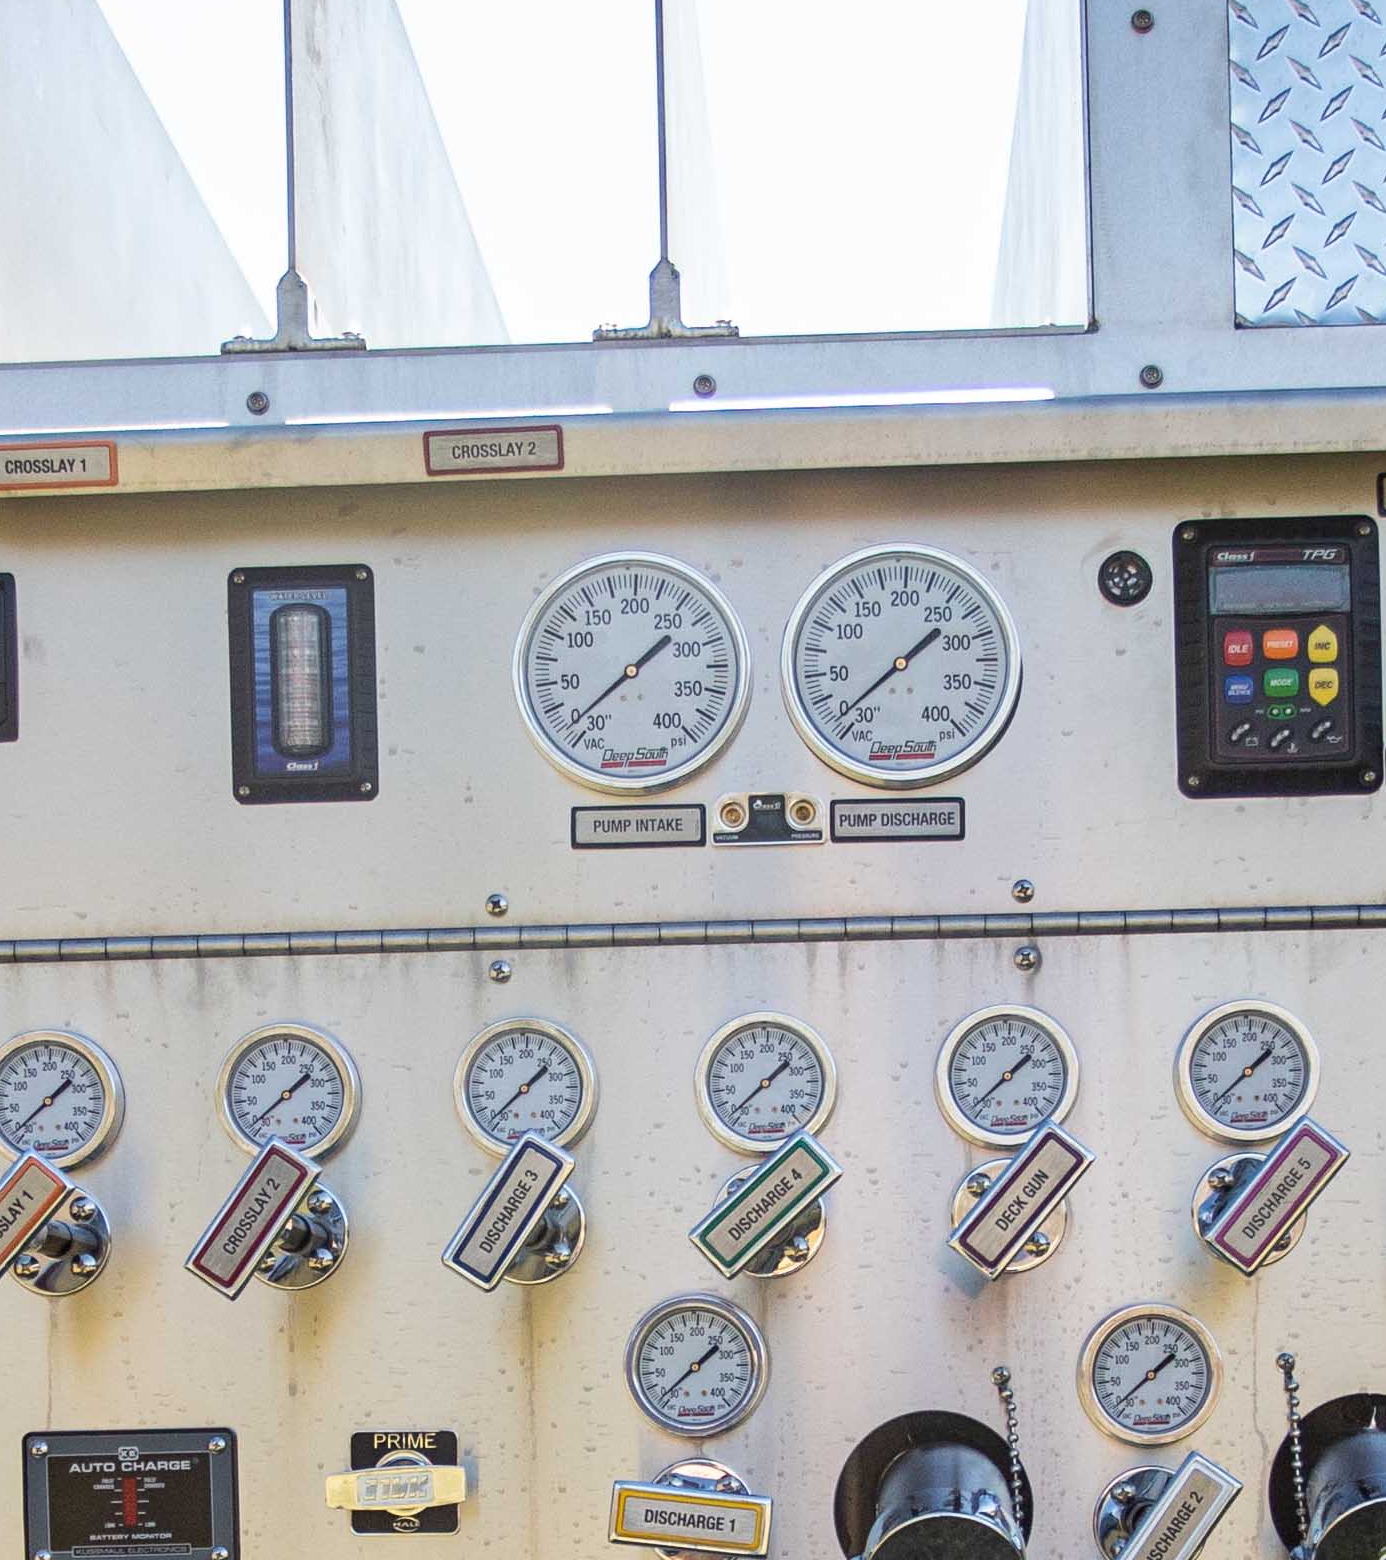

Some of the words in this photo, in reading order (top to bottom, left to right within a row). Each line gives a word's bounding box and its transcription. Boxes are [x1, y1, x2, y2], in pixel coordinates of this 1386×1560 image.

[451, 443, 524, 460] CROSSLAY
[527, 441, 537, 457] 2
[5, 458, 75, 476] CROSSLAY
[81, 458, 88, 474] 1
[1301, 548, 1337, 561] TPG
[620, 598, 650, 615] 200
[890, 590, 919, 607] 200
[854, 601, 881, 618] 150
[924, 606, 952, 623] 250
[585, 610, 612, 626] 150
[654, 614, 682, 630] 250
[836, 623, 863, 640] 100
[567, 632, 594, 648] 100
[942, 635, 971, 651] 300
[1314, 642, 1331, 650] INC
[673, 642, 701, 658] 300
[1228, 644, 1250, 654] IDLE
[829, 666, 849, 681] 50
[561, 674, 580, 690] 50
[674, 680, 703, 697] 350
[943, 674, 971, 690] 350
[1270, 678, 1294, 687] MODE
[1315, 680, 1333, 689] DEC
[571, 708, 580, 724] 0
[839, 700, 849, 716] 0
[921, 706, 950, 722] 400
[653, 712, 682, 729] 400
[670, 734, 687, 750] psi
[851, 730, 873, 742] VAC
[939, 727, 956, 742] psi
[584, 738, 605, 750] VAC
[593, 818, 632, 833] PUMP
[635, 817, 683, 833] INTAKE
[839, 814, 878, 829] PUMP
[880, 811, 956, 828] DISCHARGE
[740, 1050, 754, 1060] 150
[760, 1043, 775, 1053] 200
[778, 1052, 793, 1062] 250
[730, 1063, 744, 1073] 100
[788, 1066, 804, 1076] 300
[725, 1085, 736, 1095] 50
[789, 1089, 805, 1099] 350
[780, 1104, 796, 1114] 400
[21, 1189, 34, 1205] 1
[727, 1181, 794, 1242] DISCHARGE
[790, 1168, 803, 1182] 4
[994, 1196, 1026, 1232] DECK
[1022, 1169, 1050, 1199] GUN
[1242, 1169, 1304, 1241] DISCHARGE
[1299, 1156, 1312, 1170] 5
[222, 1191, 273, 1256] CROSSLAY
[267, 1177, 281, 1192] 2
[479, 1183, 532, 1254] DISCHARGE
[525, 1169, 539, 1182] 3
[670, 1333, 684, 1343] 150
[689, 1327, 705, 1337] 200
[708, 1335, 723, 1345] 250
[659, 1346, 675, 1355] 100
[718, 1350, 734, 1360] 300
[655, 1368, 665, 1378] 50
[719, 1372, 735, 1382] 350
[710, 1387, 726, 1397] 400
[373, 1432, 438, 1449] PRIME
[69, 1462, 116, 1474] AUTO
[121, 1460, 191, 1472] CHARGE
[1190, 1490, 1204, 1505] 2
[644, 1508, 726, 1531] DISCHARGE
[729, 1518, 736, 1533] 1
[89, 1533, 129, 1541] BATTERY
[131, 1532, 172, 1540] MONITOR
[127, 1546, 189, 1554] ELECTRONICS
